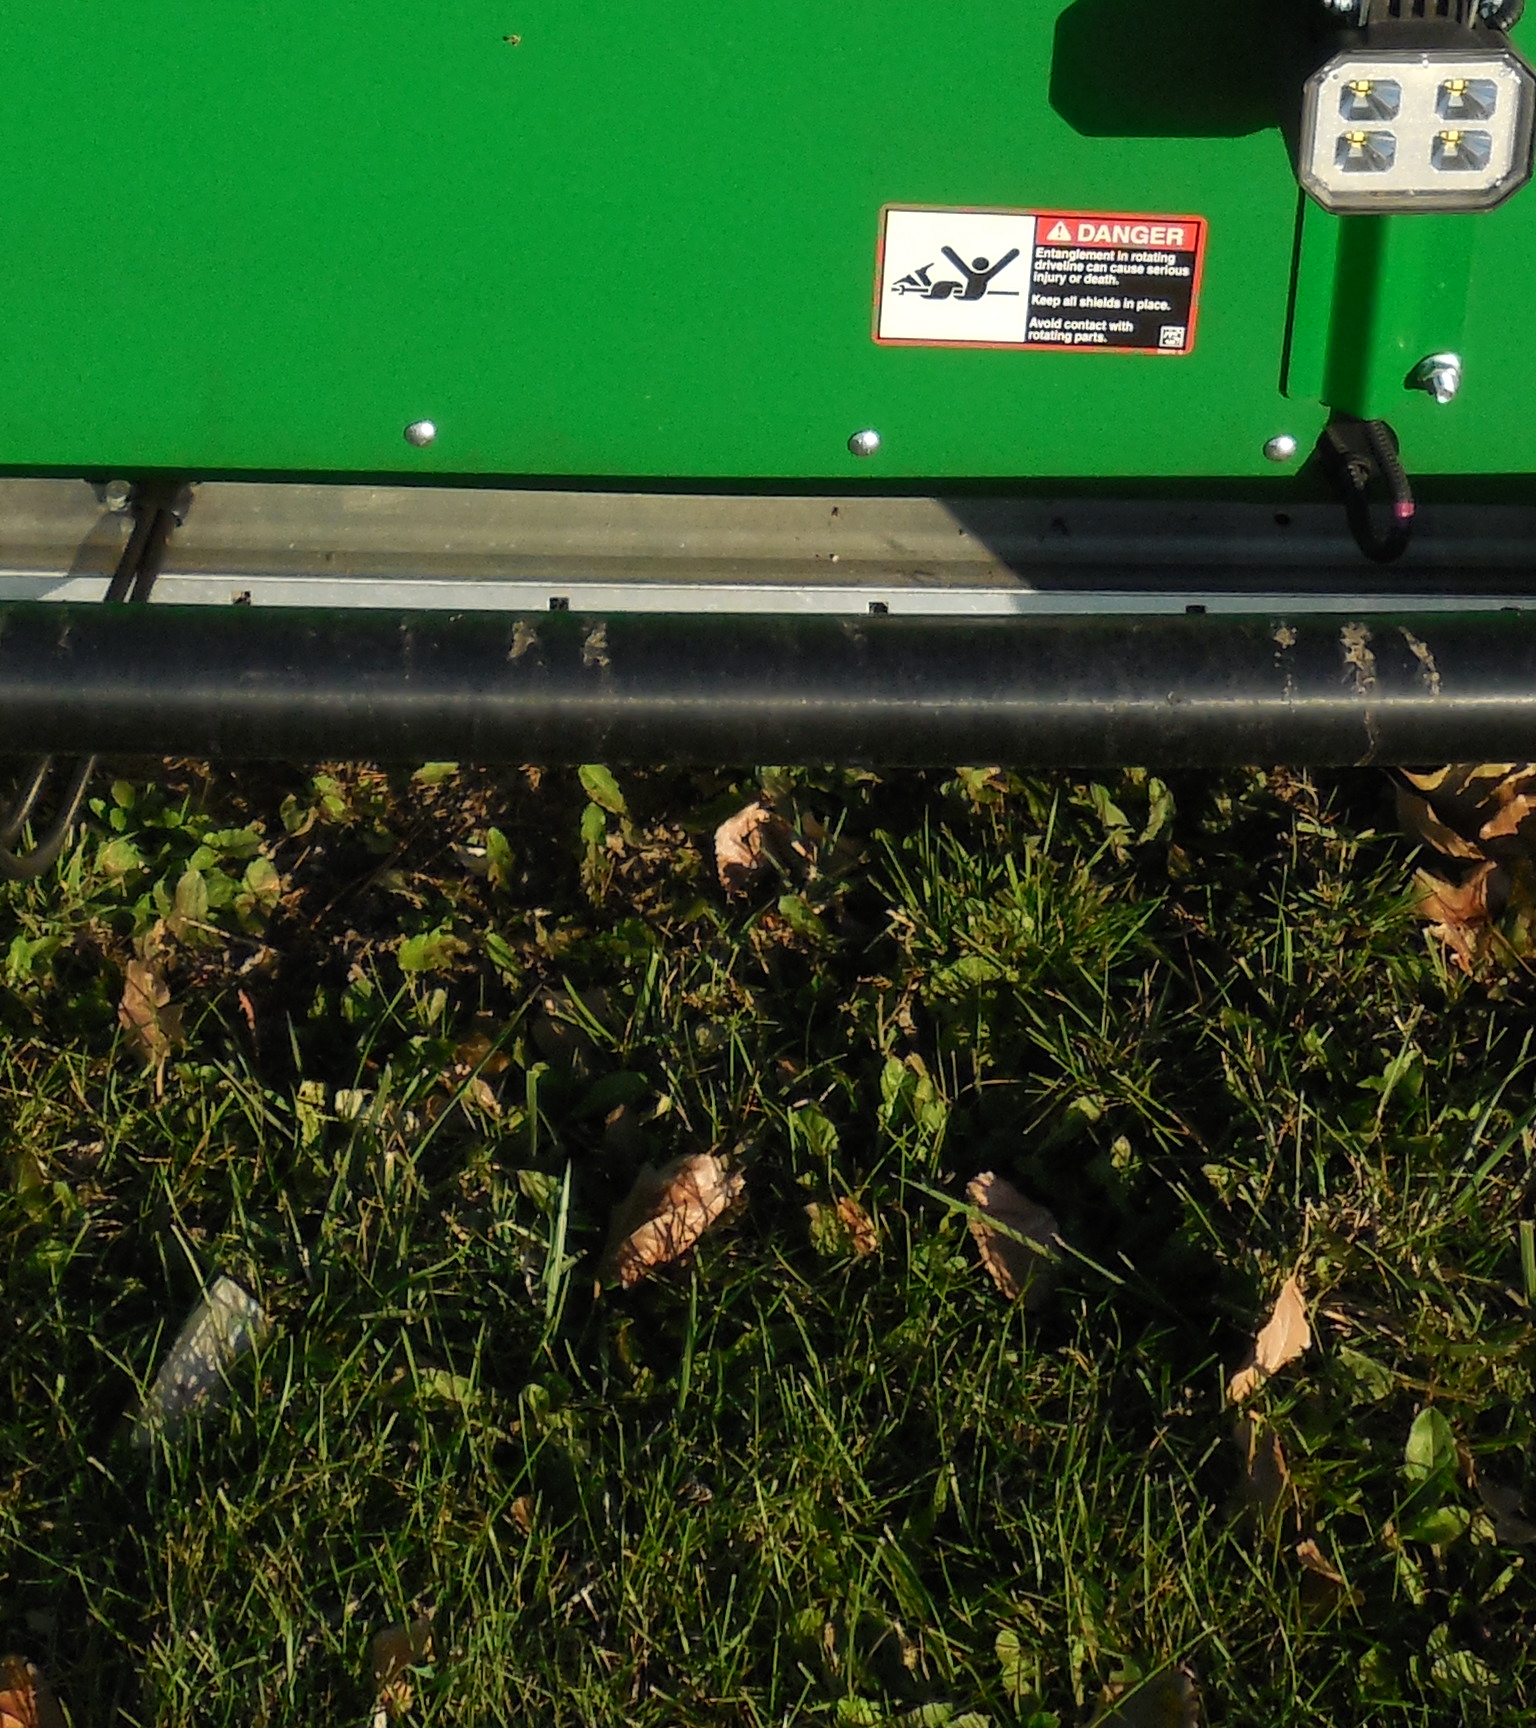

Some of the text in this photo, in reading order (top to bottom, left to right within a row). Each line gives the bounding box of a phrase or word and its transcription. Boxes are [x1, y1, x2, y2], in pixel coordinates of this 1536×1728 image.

[1077, 224, 1185, 246] DANGER
[1035, 247, 1176, 265] Entanglement in rotating
[1034, 259, 1190, 276] driveline can cause serious
[1033, 272, 1120, 286] injury or death.
[1031, 294, 1172, 312] Keep all shields in place.
[1029, 317, 1134, 332] Avoid contact with
[1028, 329, 1108, 344] rotating parts.
